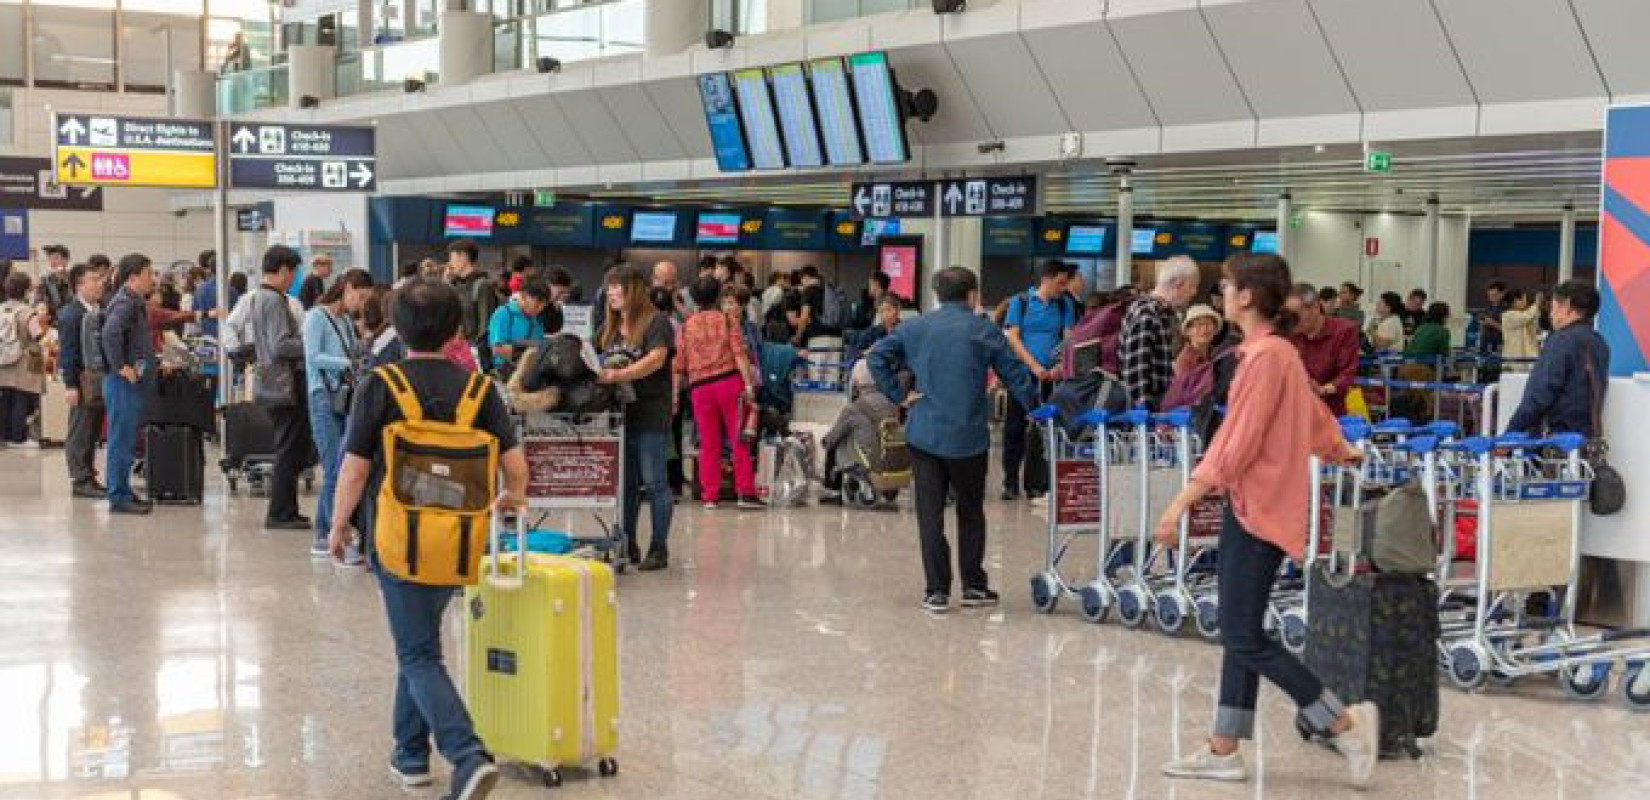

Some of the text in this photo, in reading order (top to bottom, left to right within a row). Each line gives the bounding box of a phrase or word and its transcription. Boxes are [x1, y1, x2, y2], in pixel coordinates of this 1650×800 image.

[290, 130, 331, 141] Check-in
[273, 162, 315, 173] Check-in
[894, 186, 926, 199] Check-in
[991, 183, 1027, 196] Check-in
